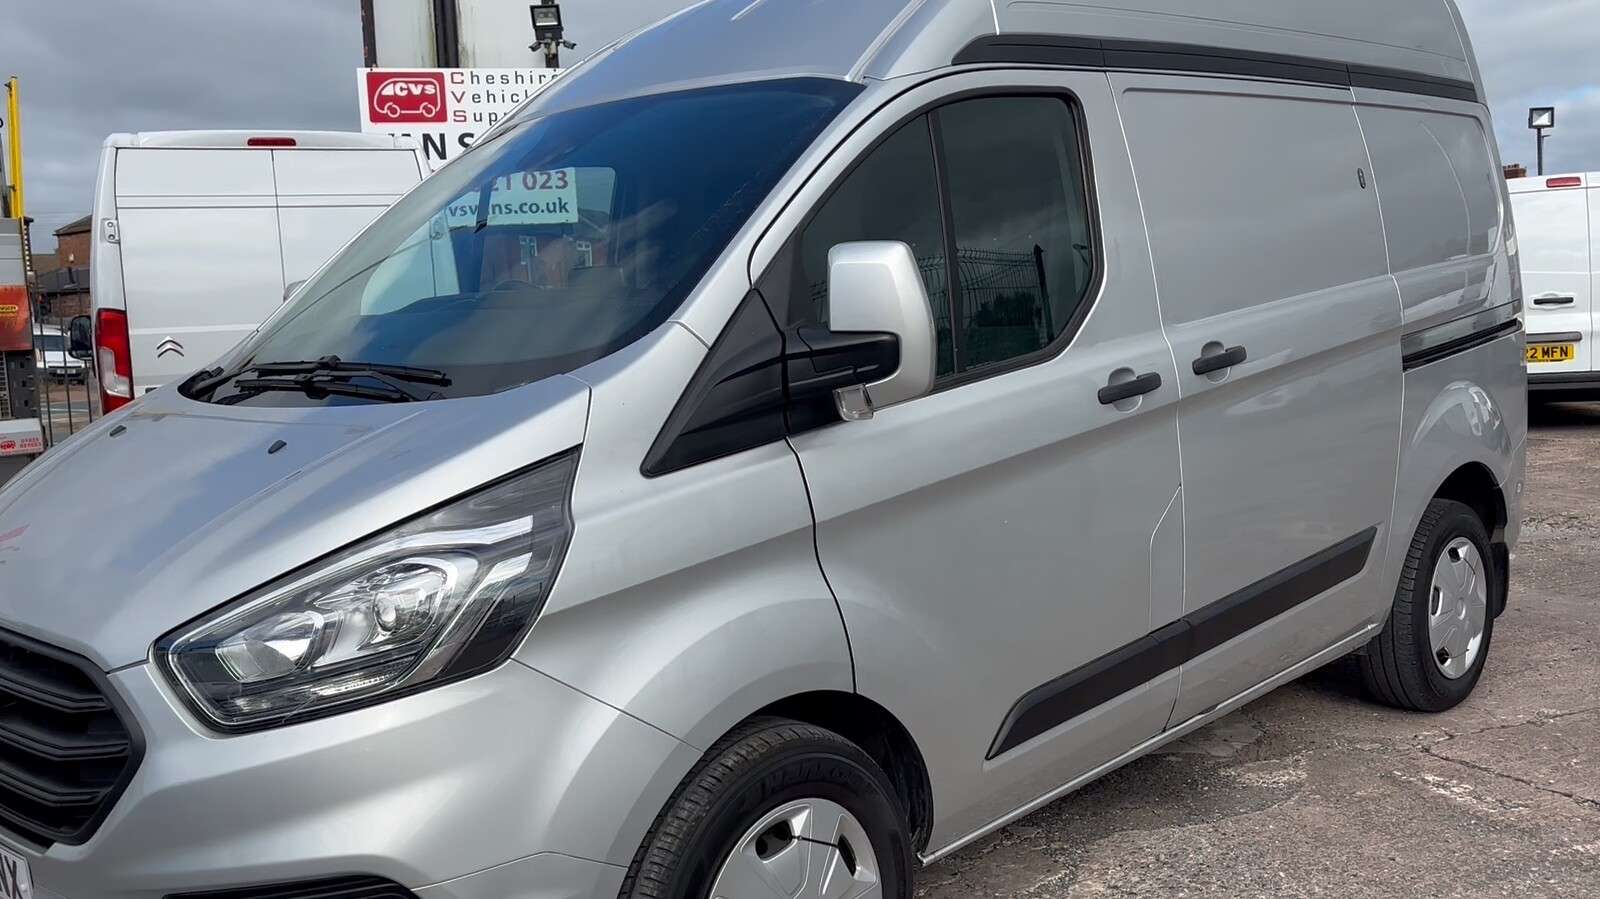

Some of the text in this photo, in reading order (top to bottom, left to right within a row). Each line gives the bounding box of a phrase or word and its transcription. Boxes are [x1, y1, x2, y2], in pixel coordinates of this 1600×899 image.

[453, 110, 507, 126] Sup
[522, 170, 569, 191] 023
[448, 197, 570, 217] vsvns.co.uk
[1525, 346, 1569, 359] 2 MFN
